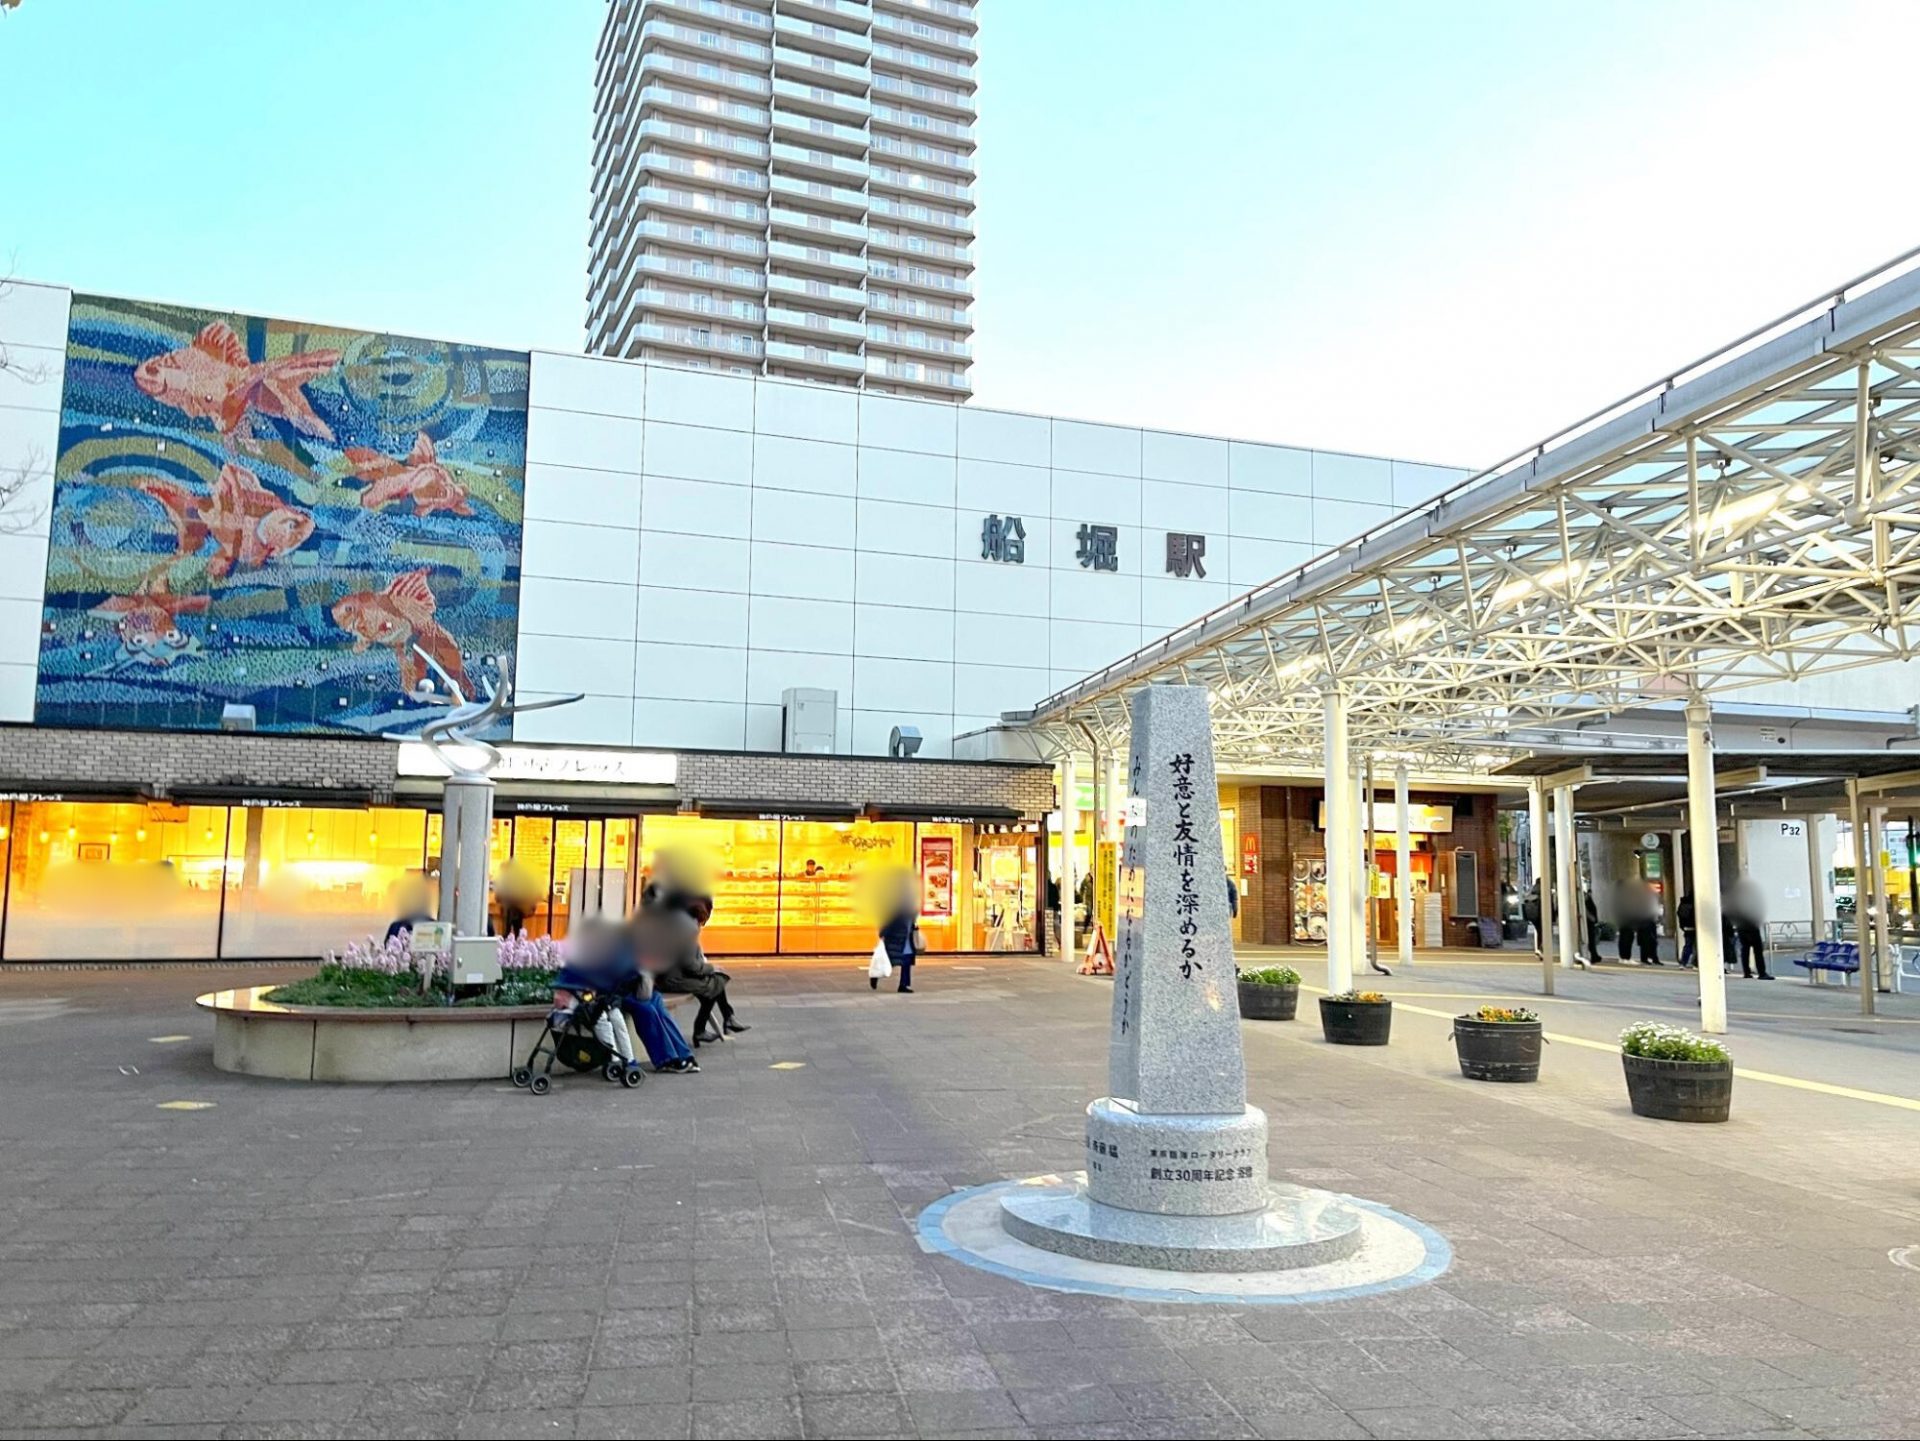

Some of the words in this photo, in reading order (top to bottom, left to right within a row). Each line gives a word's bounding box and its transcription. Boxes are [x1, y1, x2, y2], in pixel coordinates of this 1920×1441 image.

[981, 514, 1207, 579] 船堀駅
[1169, 753, 1203, 980] 好意と友情を深めるか
